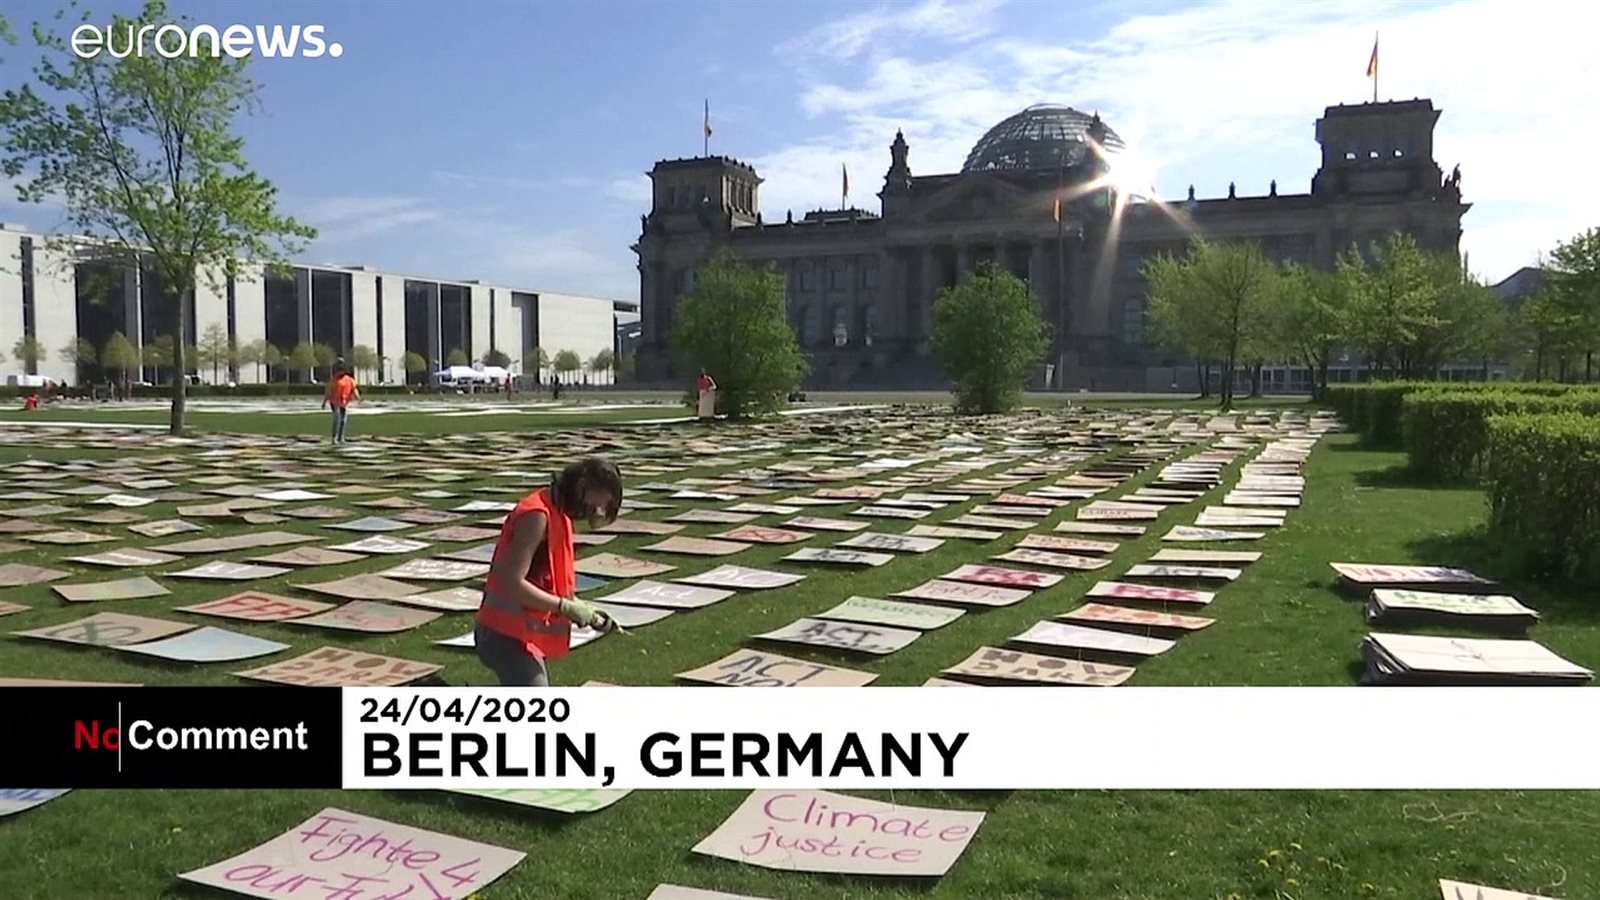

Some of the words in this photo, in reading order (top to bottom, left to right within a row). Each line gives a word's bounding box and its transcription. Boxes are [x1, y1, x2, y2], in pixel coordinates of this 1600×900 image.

[718, 656, 837, 687] ACT
[763, 793, 970, 843] Climate
[740, 825, 923, 863] justice
